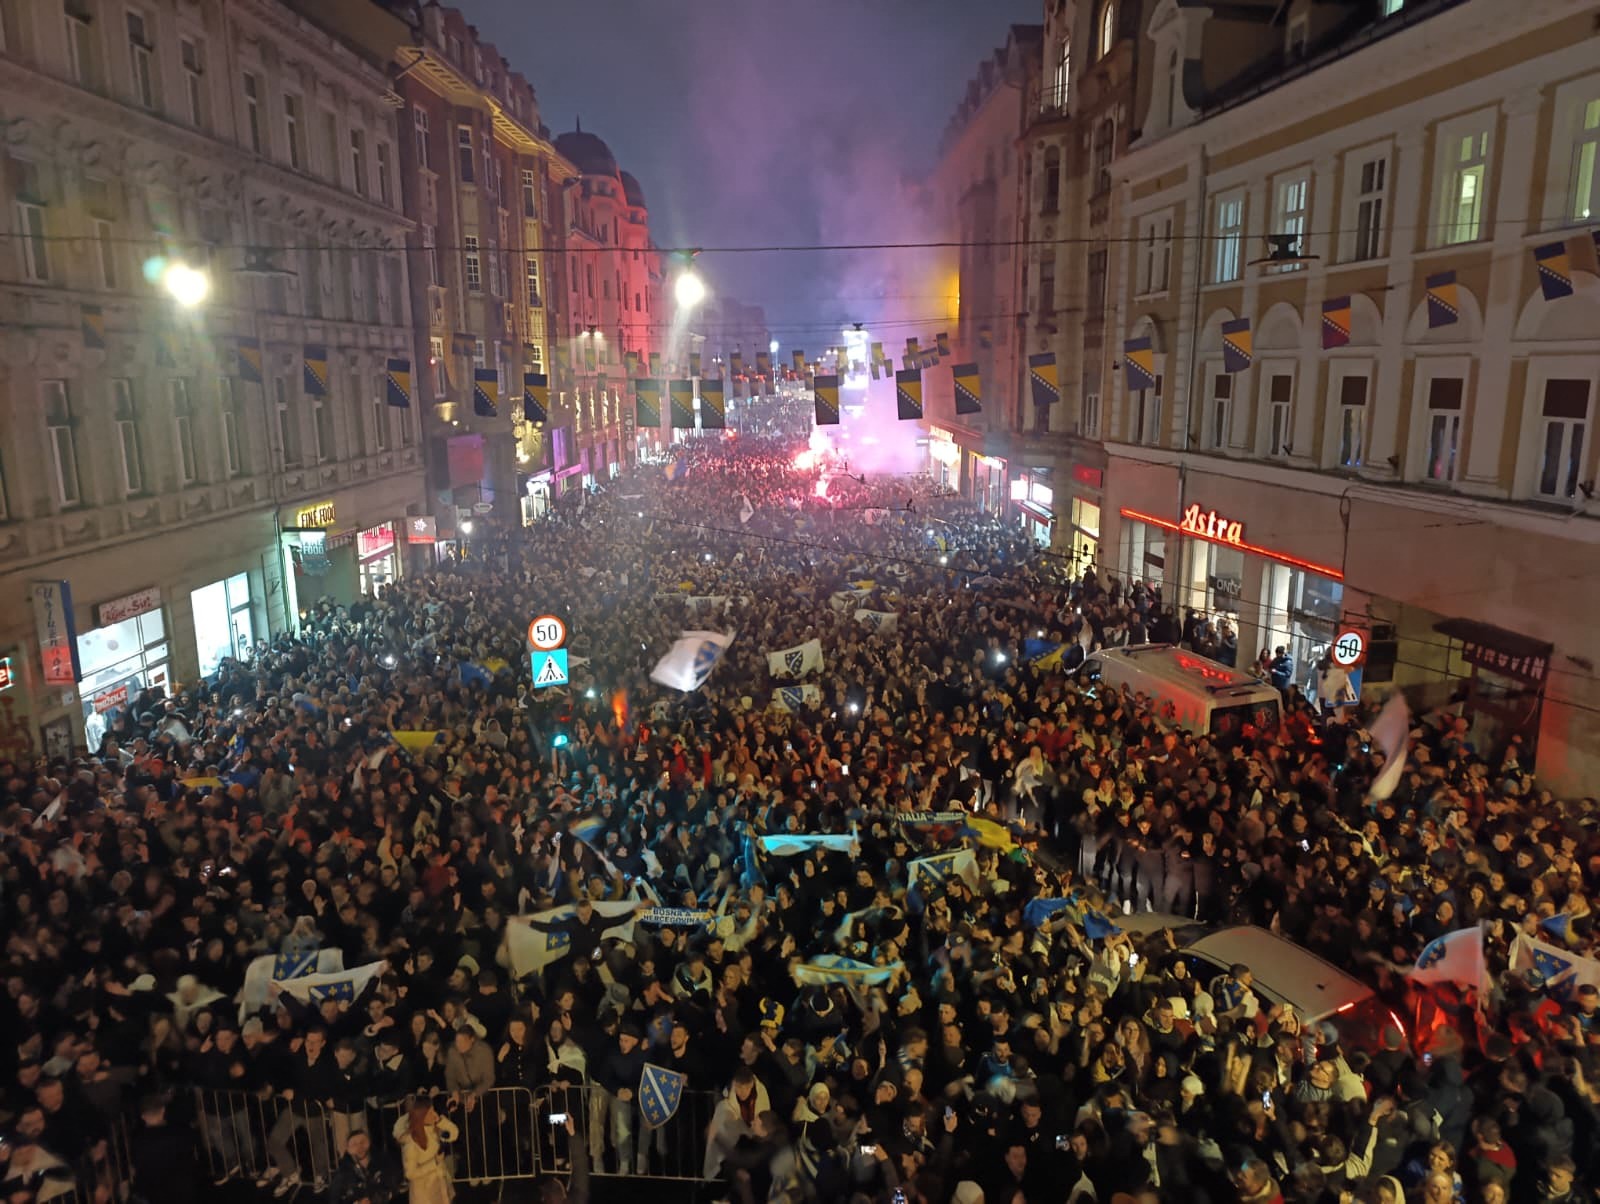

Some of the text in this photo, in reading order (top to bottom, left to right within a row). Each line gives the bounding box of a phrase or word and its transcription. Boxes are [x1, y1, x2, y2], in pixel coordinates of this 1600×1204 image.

[301, 510, 318, 528] FINE
[1181, 503, 1242, 544] Astra
[303, 545, 324, 555] FOOD
[537, 624, 557, 641] 50
[1339, 638, 1358, 658] 50
[652, 907, 682, 917] BOSNA
